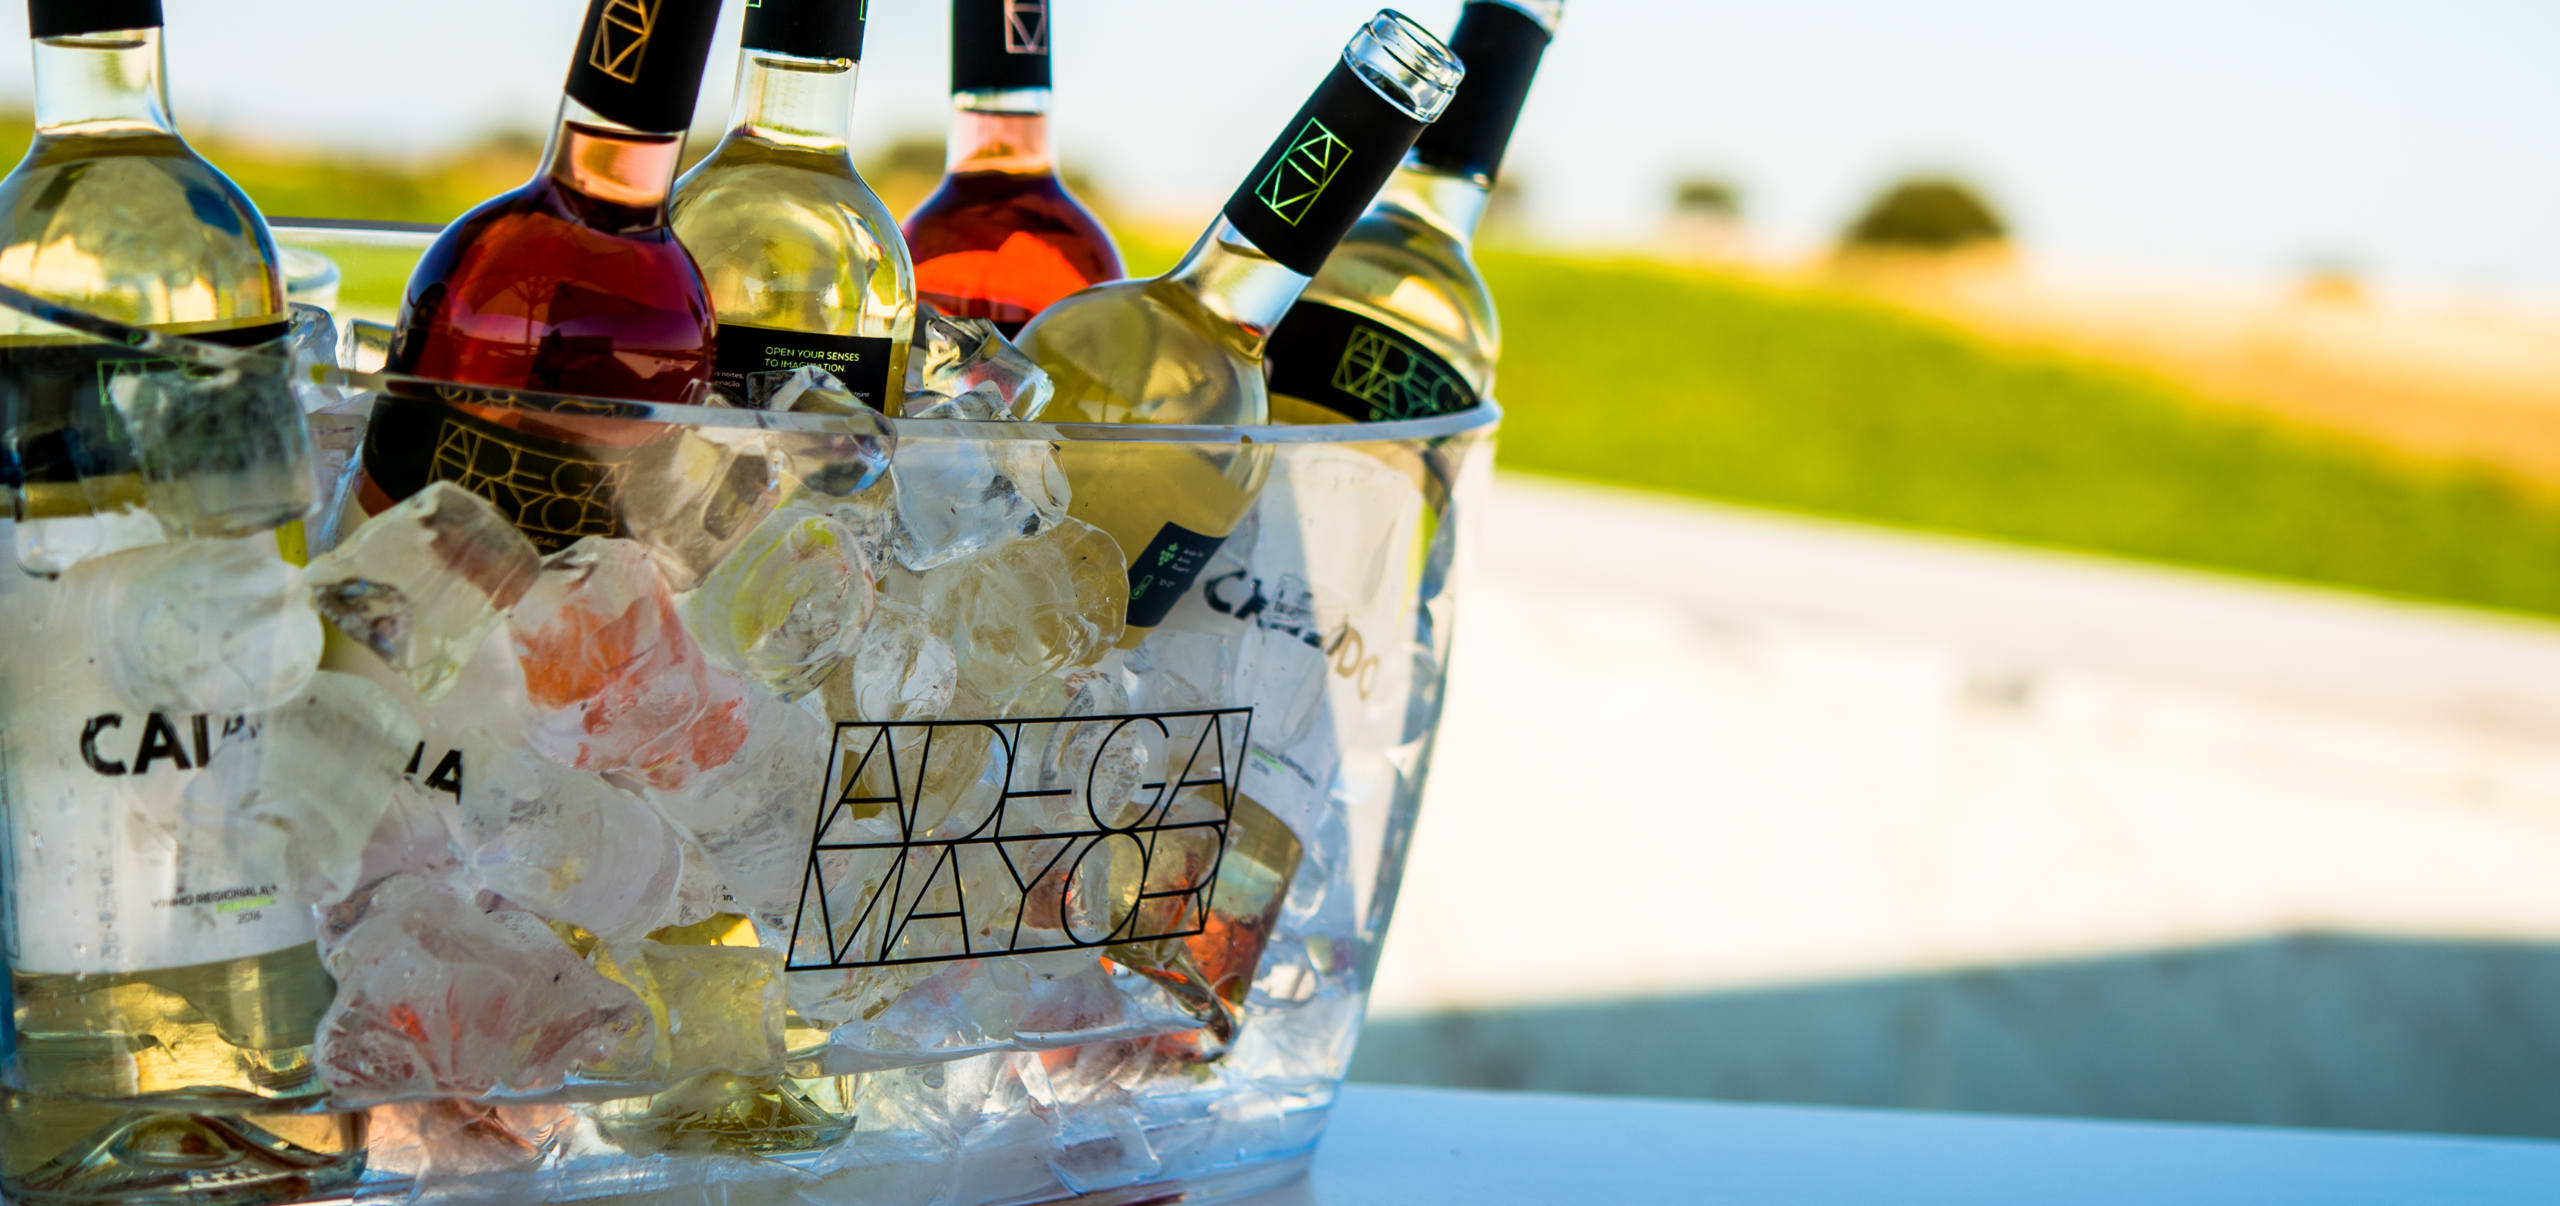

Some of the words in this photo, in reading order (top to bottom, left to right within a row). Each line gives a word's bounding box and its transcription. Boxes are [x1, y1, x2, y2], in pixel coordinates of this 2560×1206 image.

[764, 358, 779, 368] TO
[765, 346, 795, 357] OPEN
[797, 349, 825, 360] YOUR
[826, 351, 860, 362] SENSES
[815, 707, 1245, 847] ADEGA
[786, 822, 1227, 971] MAYOR
